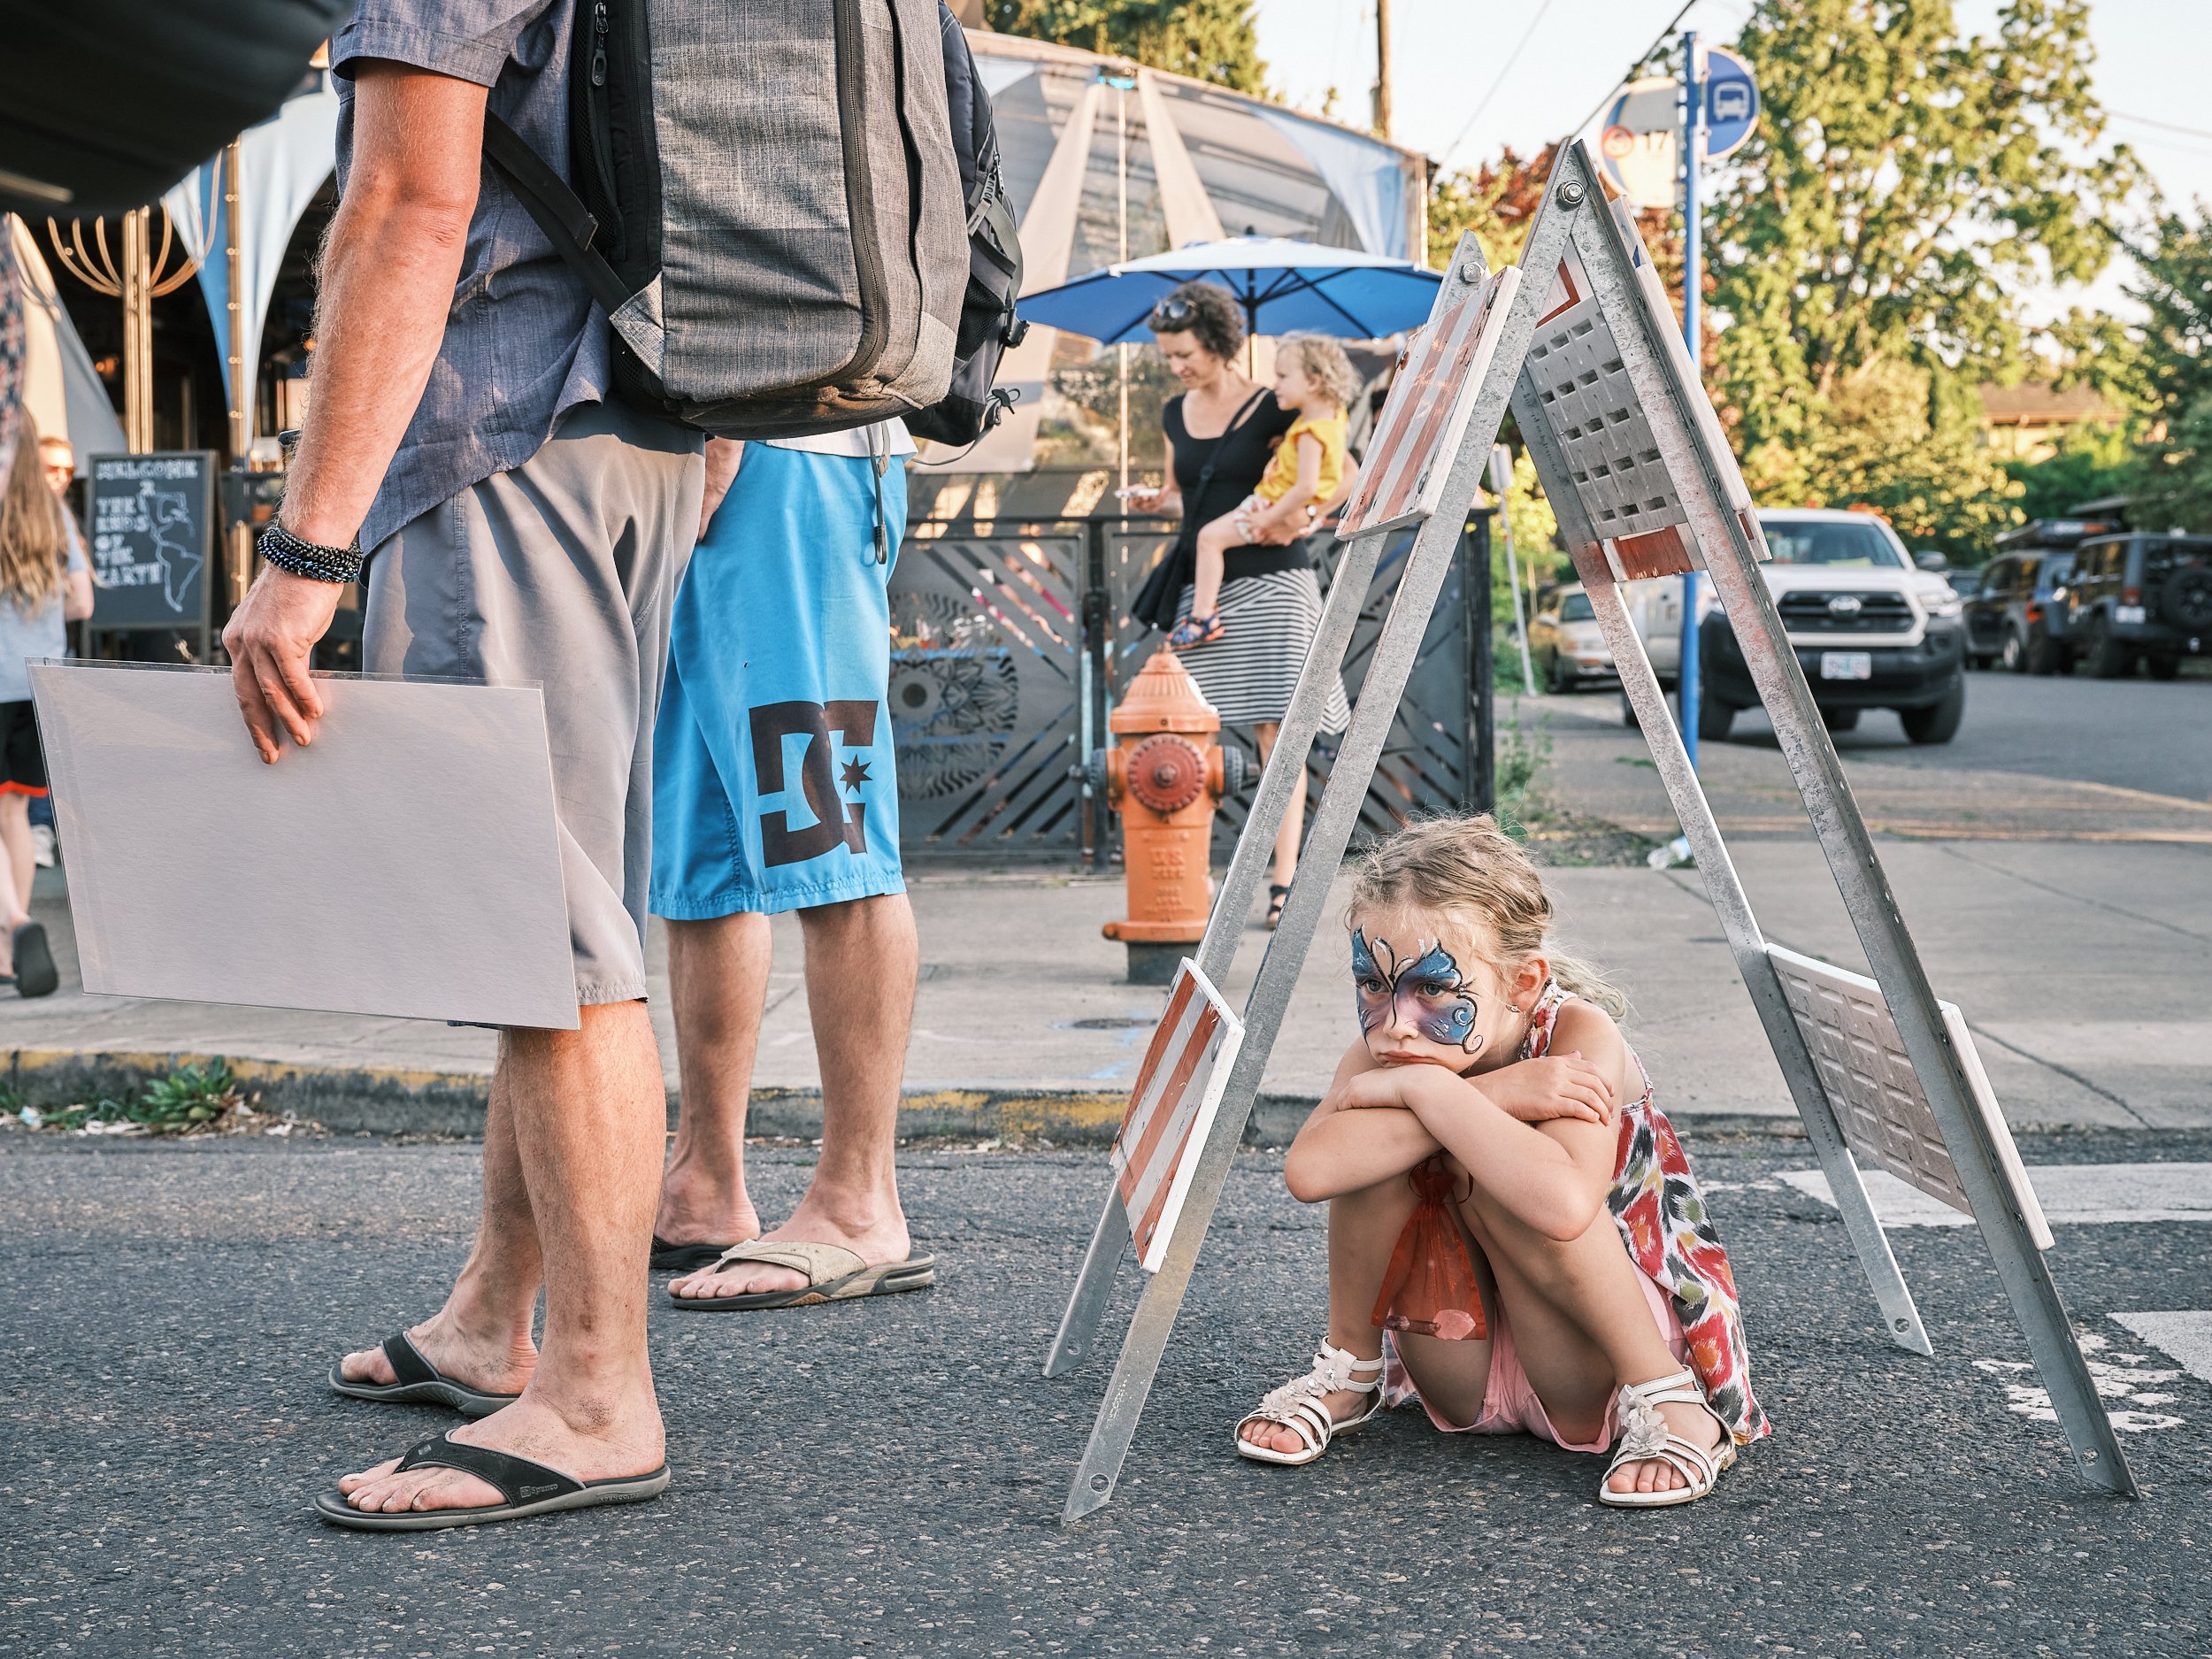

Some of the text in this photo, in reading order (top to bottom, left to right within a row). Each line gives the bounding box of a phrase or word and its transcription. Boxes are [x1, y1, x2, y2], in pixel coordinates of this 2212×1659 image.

[97, 460, 197, 480] WELCOME
[96, 497, 135, 514] THE
[96, 515, 150, 532] ENDS
[95, 534, 125, 550] OF
[95, 547, 134, 566] THE
[95, 562, 162, 586] EARTH
